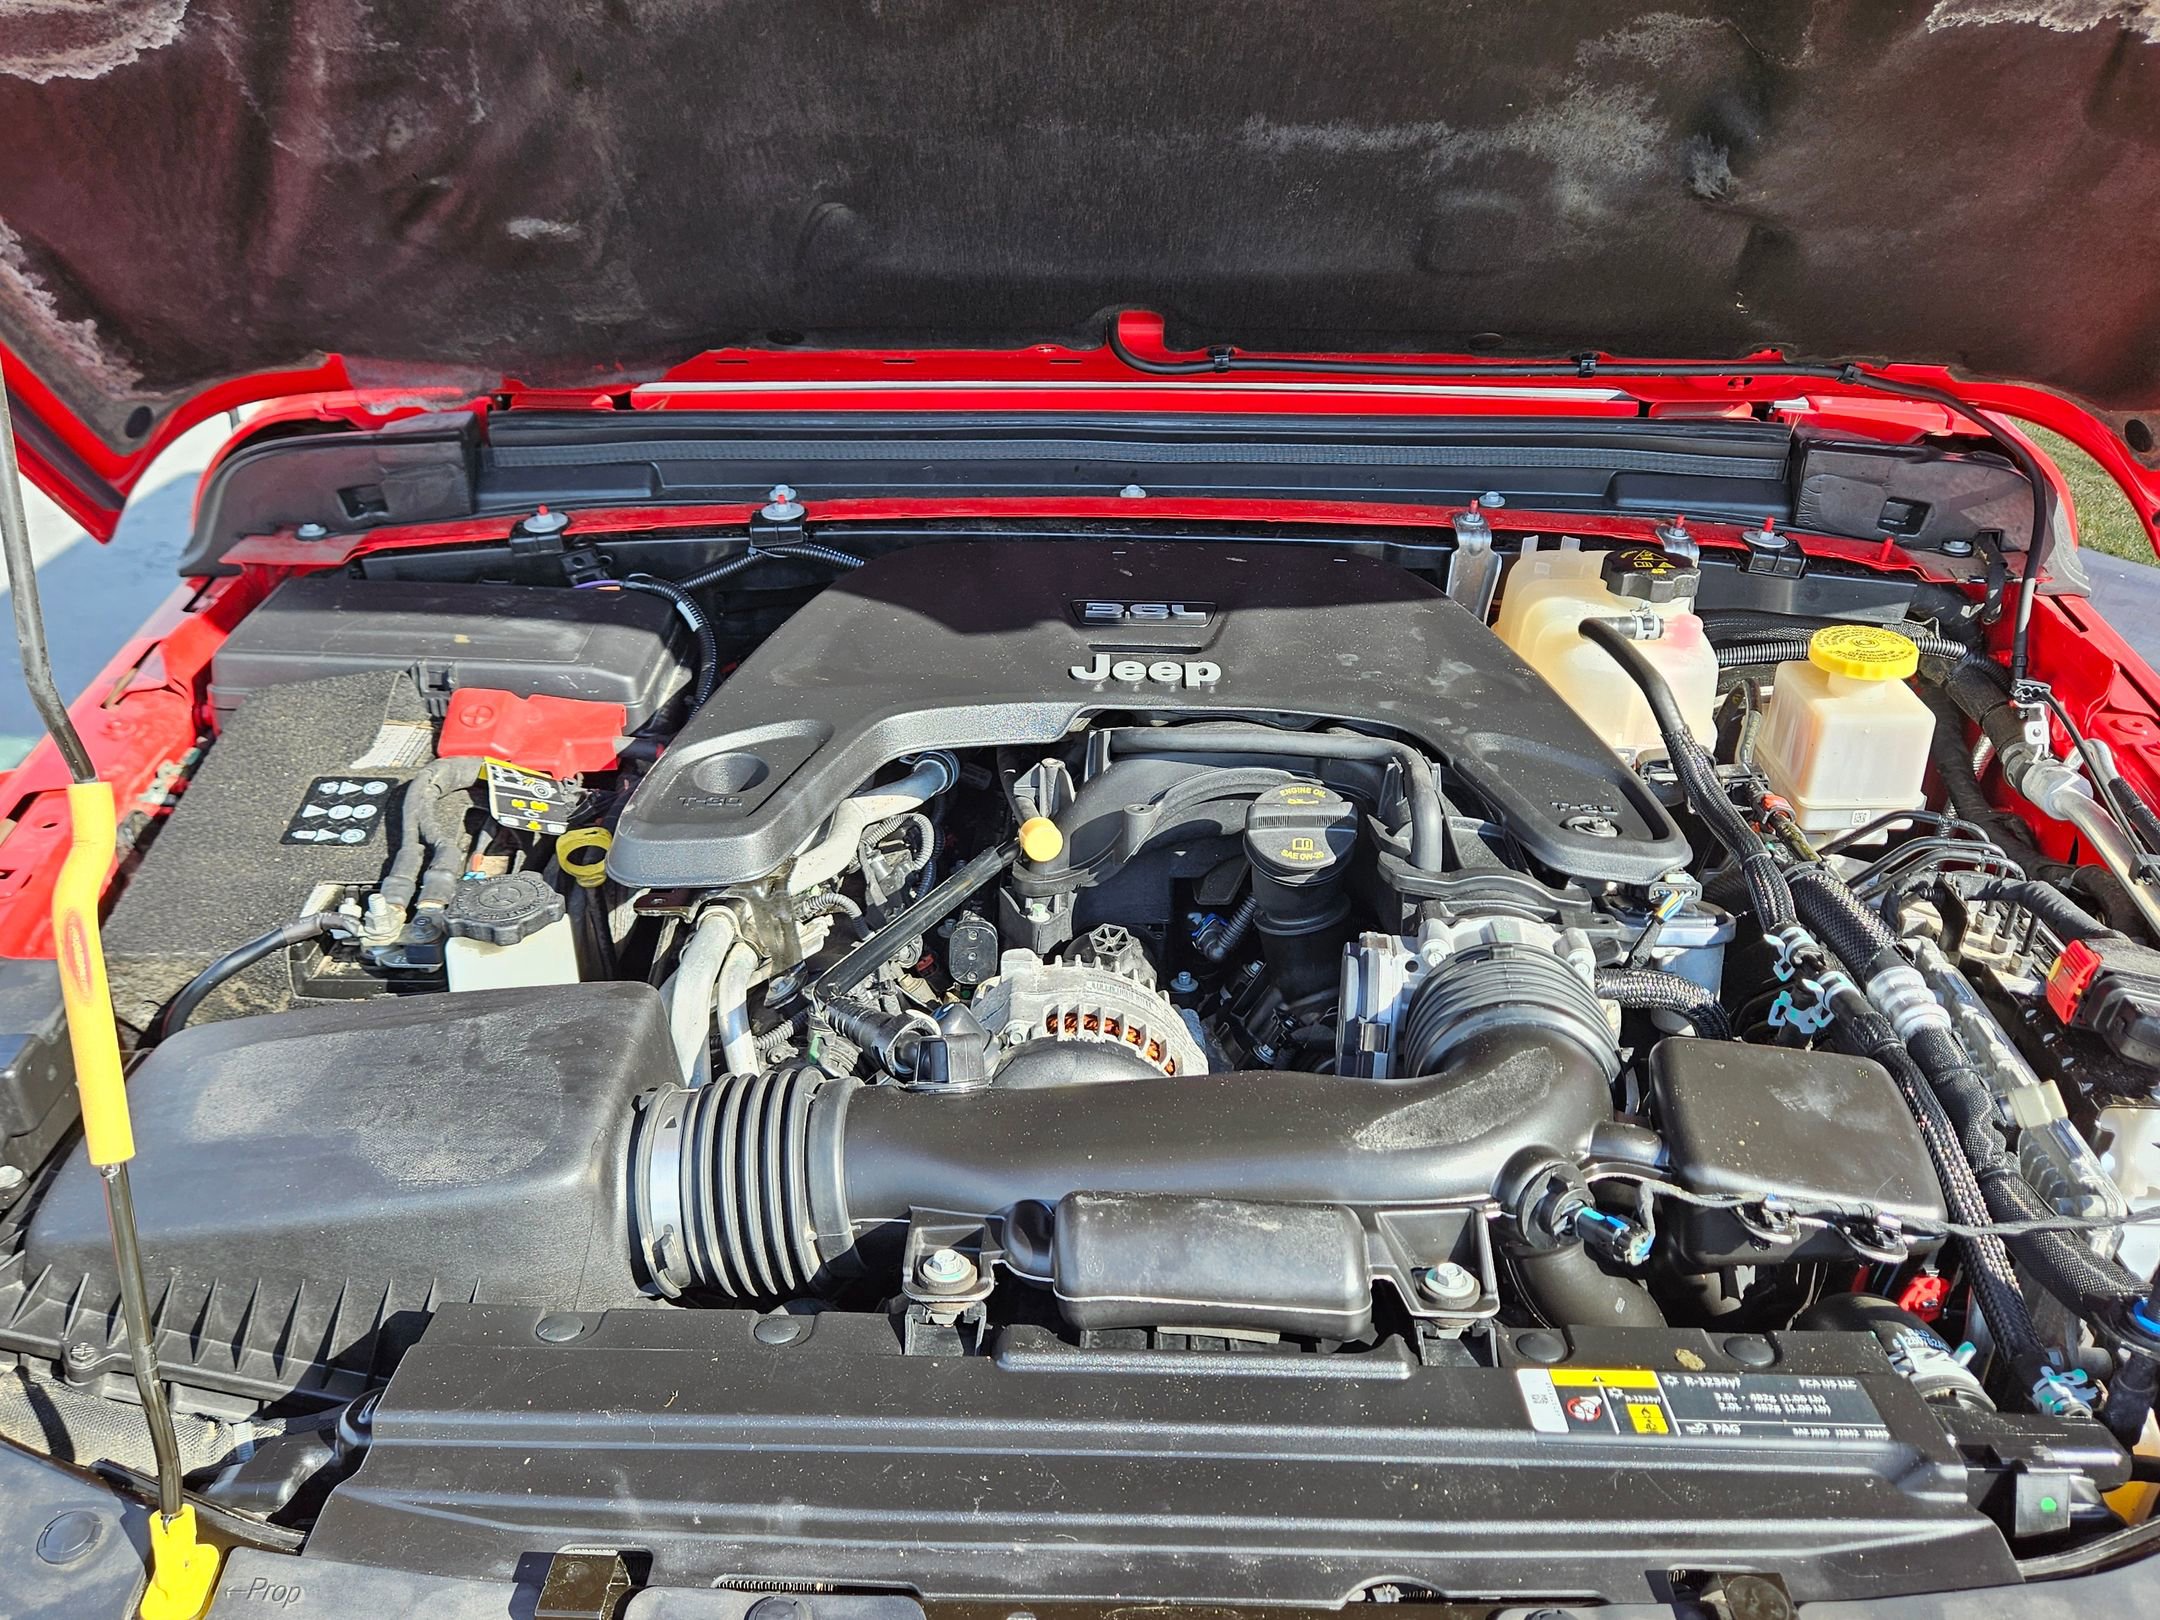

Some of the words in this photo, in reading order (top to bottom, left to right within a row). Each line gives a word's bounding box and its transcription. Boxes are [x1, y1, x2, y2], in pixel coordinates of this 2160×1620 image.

[1084, 602, 1207, 621] 3.6L
[1070, 653, 1222, 688] Jeep
[1280, 787, 1312, 797] ENGINE
[1313, 787, 1326, 798] OIL
[1281, 849, 1299, 859] SAE
[1684, 1376, 1741, 1390] R-1234yf
[1799, 1379, 1820, 1390] FCA
[1712, 1423, 1741, 1435] PAG
[246, 1577, 302, 1609] Prop
